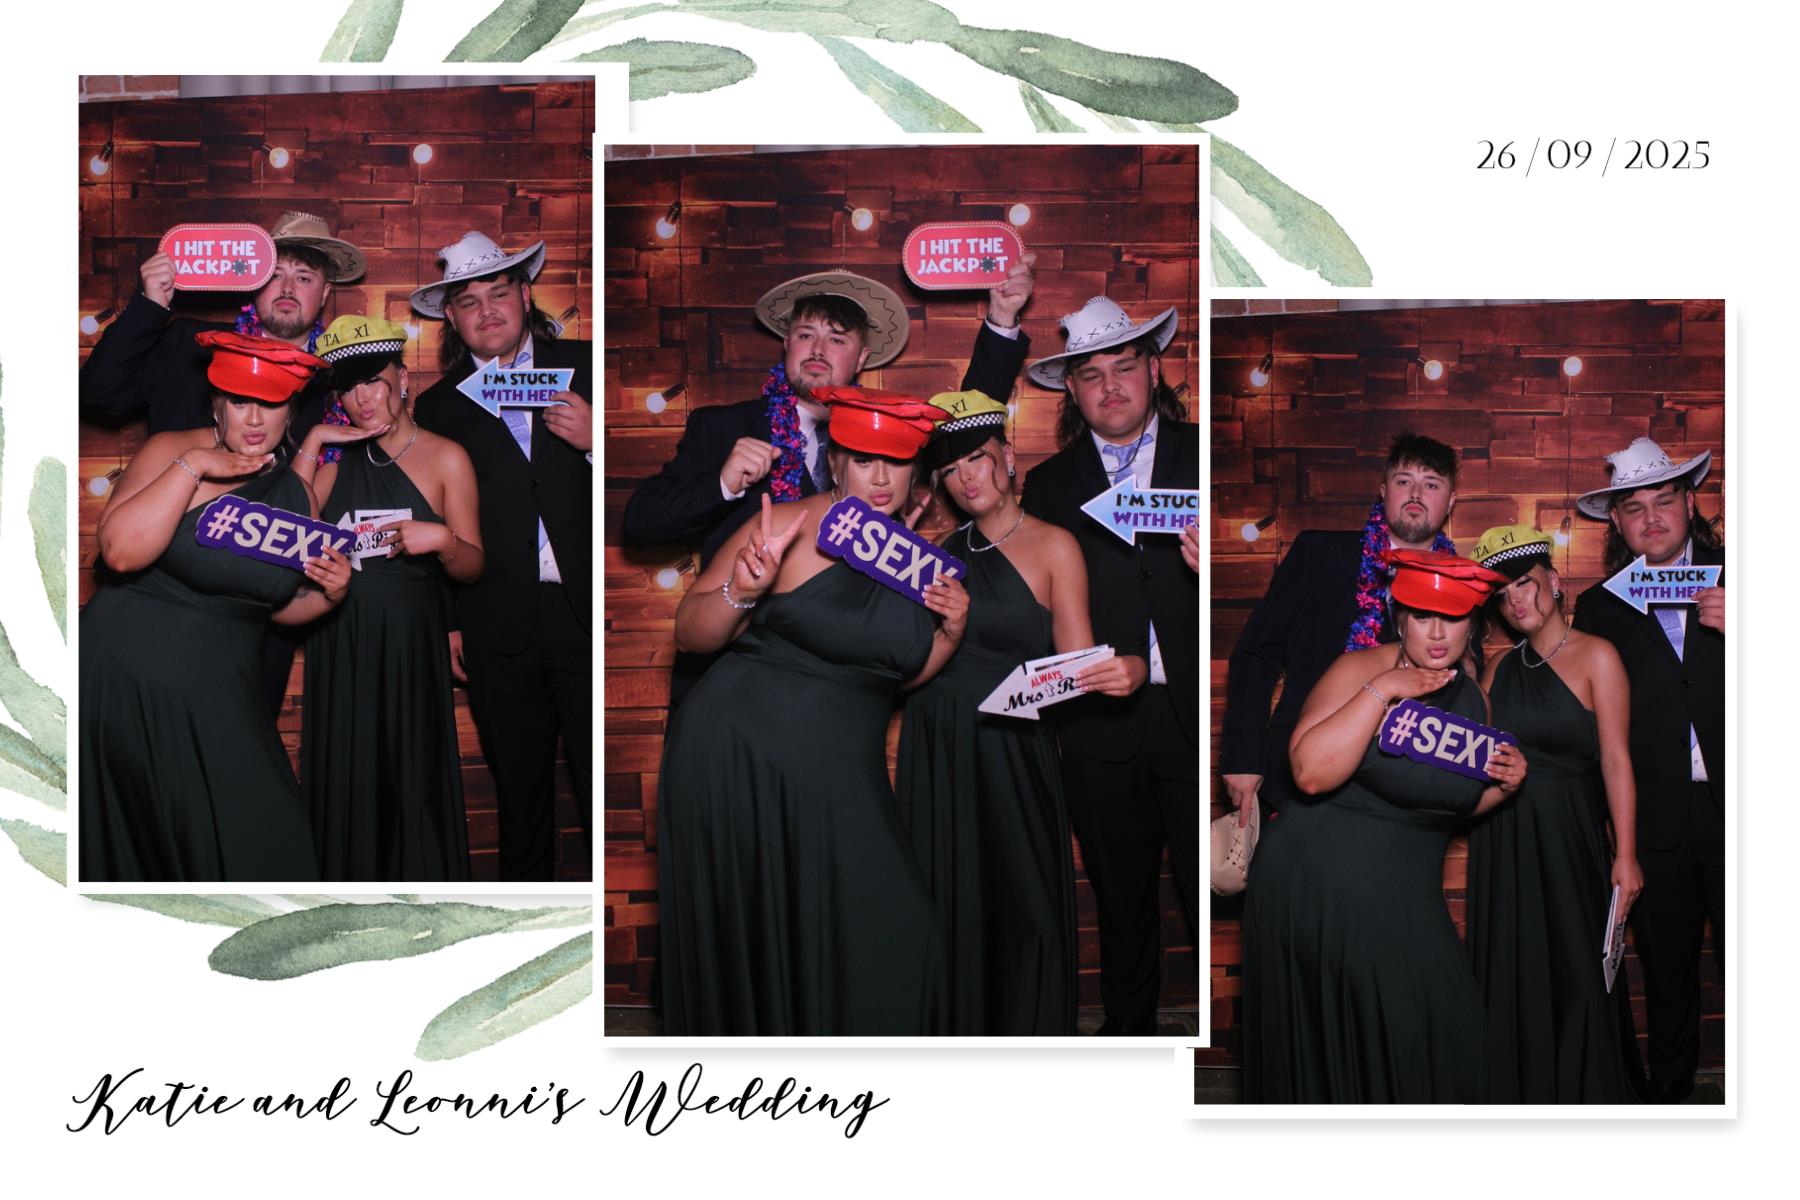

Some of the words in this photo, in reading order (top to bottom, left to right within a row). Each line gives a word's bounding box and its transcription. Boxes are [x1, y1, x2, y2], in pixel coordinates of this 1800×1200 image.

[174, 240, 180, 257] I
[184, 240, 215, 257] HIT
[220, 239, 257, 257] THE
[920, 240, 926, 256] I
[930, 239, 962, 255] HIT
[966, 237, 1003, 254] THE
[917, 255, 1008, 275] JACKPOT
[483, 373, 506, 385] I'M
[510, 373, 558, 386] STUCK
[482, 389, 523, 402] WITH
[1116, 493, 1145, 507] I'M
[1150, 494, 1199, 509] STUC
[1113, 511, 1166, 528] WITH
[1170, 513, 1199, 528] HE
[1630, 571, 1654, 583] I'M
[1657, 570, 1706, 583] STUCK
[1629, 586, 1671, 599] WITH
[1031, 671, 1063, 689] ALWAYS
[1003, 691, 1044, 712] Mrs
